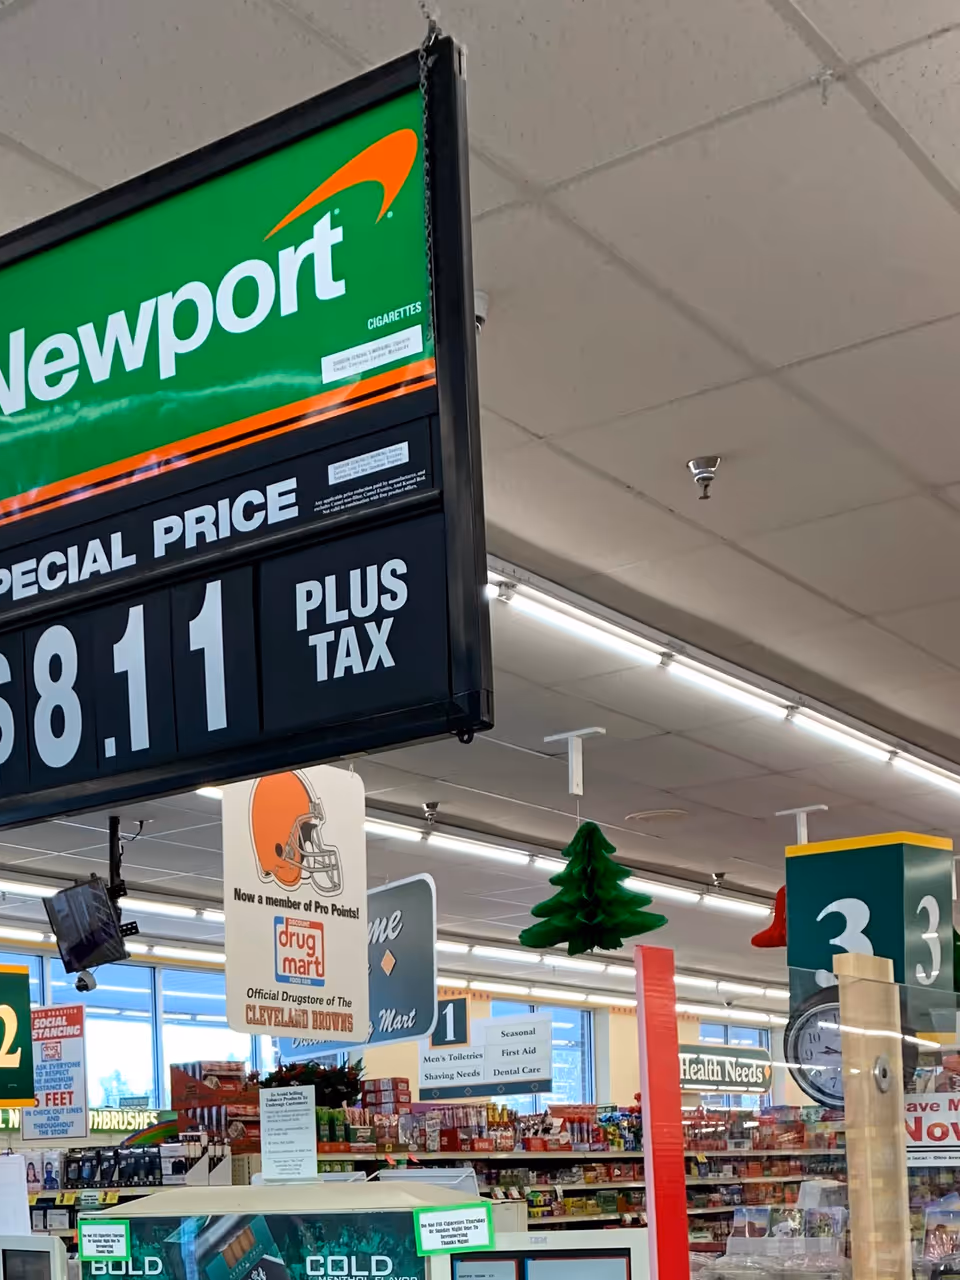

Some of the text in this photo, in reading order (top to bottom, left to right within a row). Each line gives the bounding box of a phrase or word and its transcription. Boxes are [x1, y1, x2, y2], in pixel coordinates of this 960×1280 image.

[367, 301, 422, 330] CIGARETTES
[153, 478, 299, 557] PRICE
[295, 557, 409, 631] PLUS
[307, 617, 395, 682] TAX
[234, 887, 360, 920] Now a member of Pro Points!
[287, 918, 311, 928] DISCOUNT
[278, 920, 316, 958] drug
[815, 896, 874, 988] 3
[915, 894, 941, 986] 3
[282, 955, 325, 978] mart
[246, 986, 353, 1009] Official Drugstore of The
[33, 1016, 68, 1029] SOCIAL
[244, 1003, 354, 1033] CLEVELAND BROWNS
[378, 1007, 416, 1034] Mart
[442, 1001, 457, 1042] 1
[32, 1024, 81, 1040] STANCING
[500, 1026, 537, 1039] Seasonal
[422, 1051, 484, 1064] Men's Toiletries
[501, 1046, 537, 1058] First Aid
[44, 1069, 70, 1077] RESPECT
[48, 1061, 81, 1070] EVERYONE
[423, 1068, 481, 1081] Shaving Needs
[492, 1065, 542, 1078] Dental Care
[680, 1054, 764, 1084] Health Needs
[43, 1076, 74, 1084] MINIMUM
[45, 1090, 74, 1107] FEET
[906, 1099, 944, 1114] ave
[33, 1108, 52, 1116] CHECK
[66, 1106, 83, 1114] LINES
[88, 1110, 159, 1130] THBRUSHES
[33, 1121, 75, 1130] THROUGHOUT
[50, 1128, 69, 1136] STORE
[91, 1256, 163, 1275] BOLD
[305, 1255, 393, 1277] COLD
